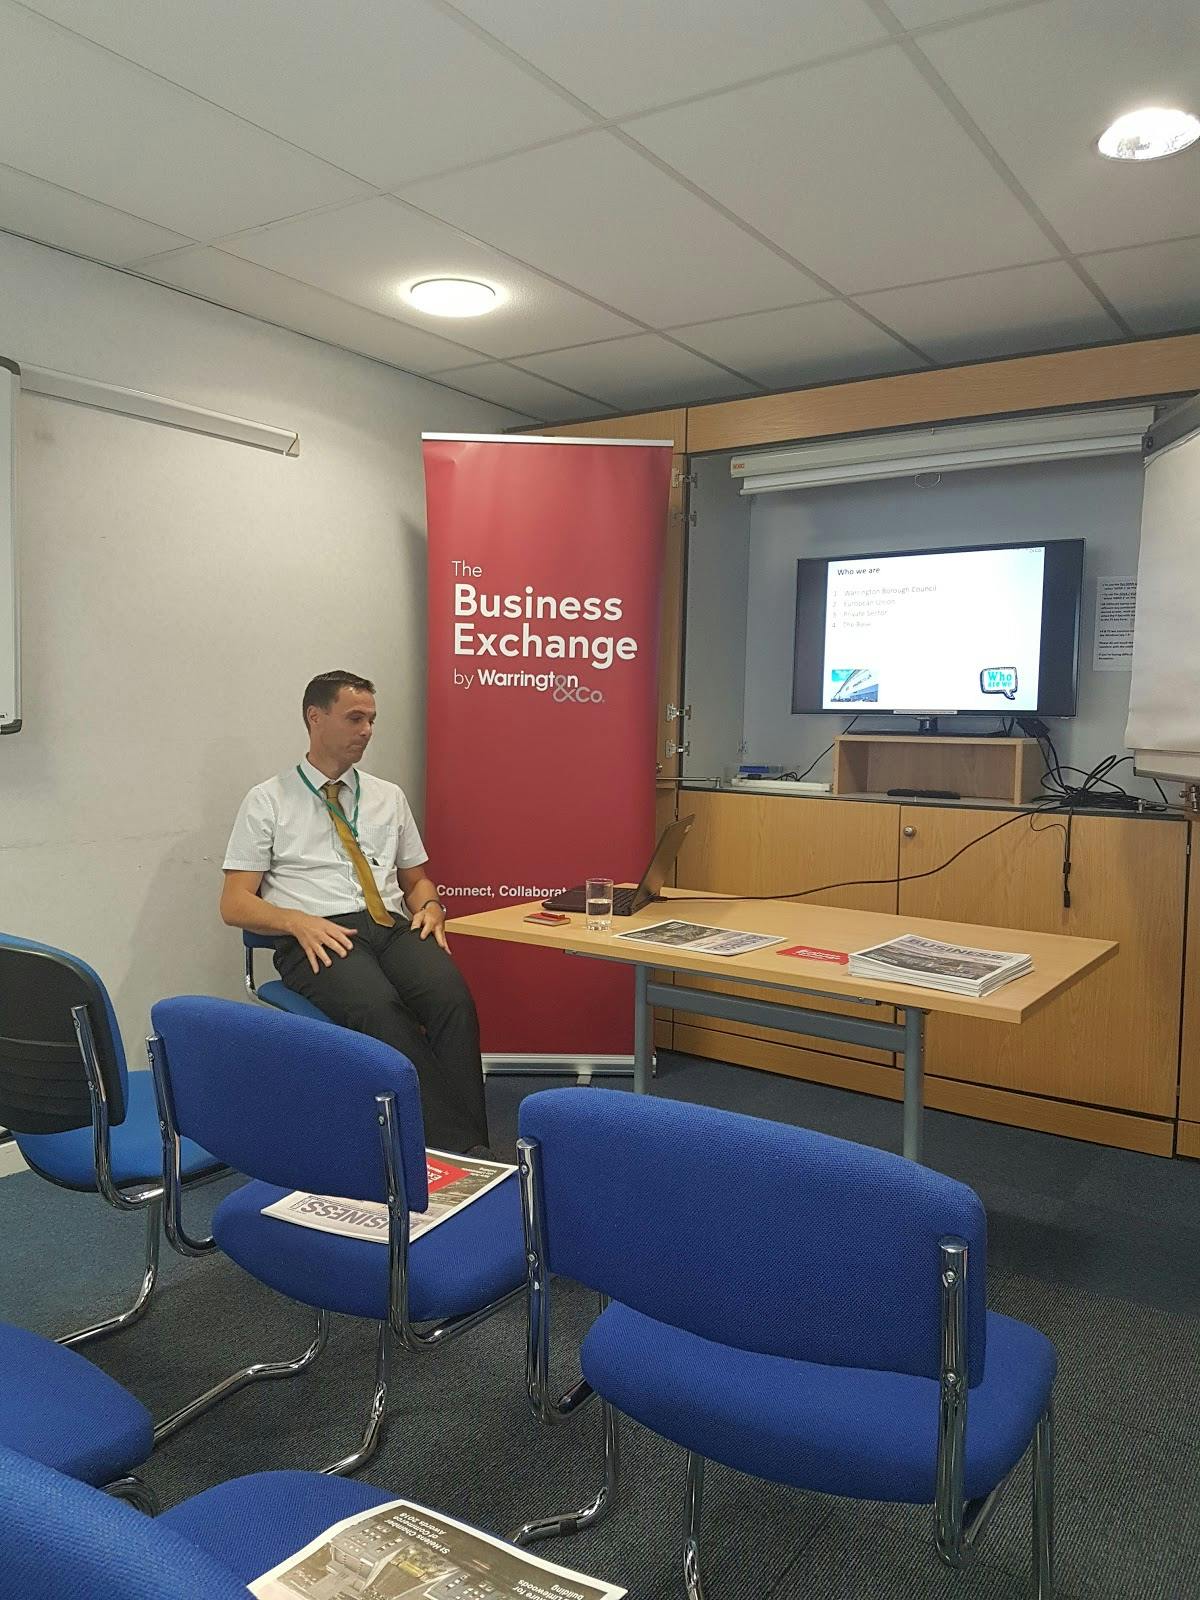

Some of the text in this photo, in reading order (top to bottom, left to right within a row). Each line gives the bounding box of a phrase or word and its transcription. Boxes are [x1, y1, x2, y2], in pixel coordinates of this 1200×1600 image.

[452, 560, 482, 577] The
[837, 568, 854, 576] Who
[454, 583, 623, 621] Business
[454, 623, 638, 669] Exchange
[453, 668, 579, 691] by Warrington
[987, 671, 1013, 682] Who
[436, 884, 567, 899] Connect, Collaborat
[909, 937, 1002, 960] BUSINESS
[300, 1199, 420, 1232] SINESS
[384, 1519, 417, 1537] Chamber
[393, 1515, 430, 1536] Commerce
[551, 1584, 585, 1600] building
